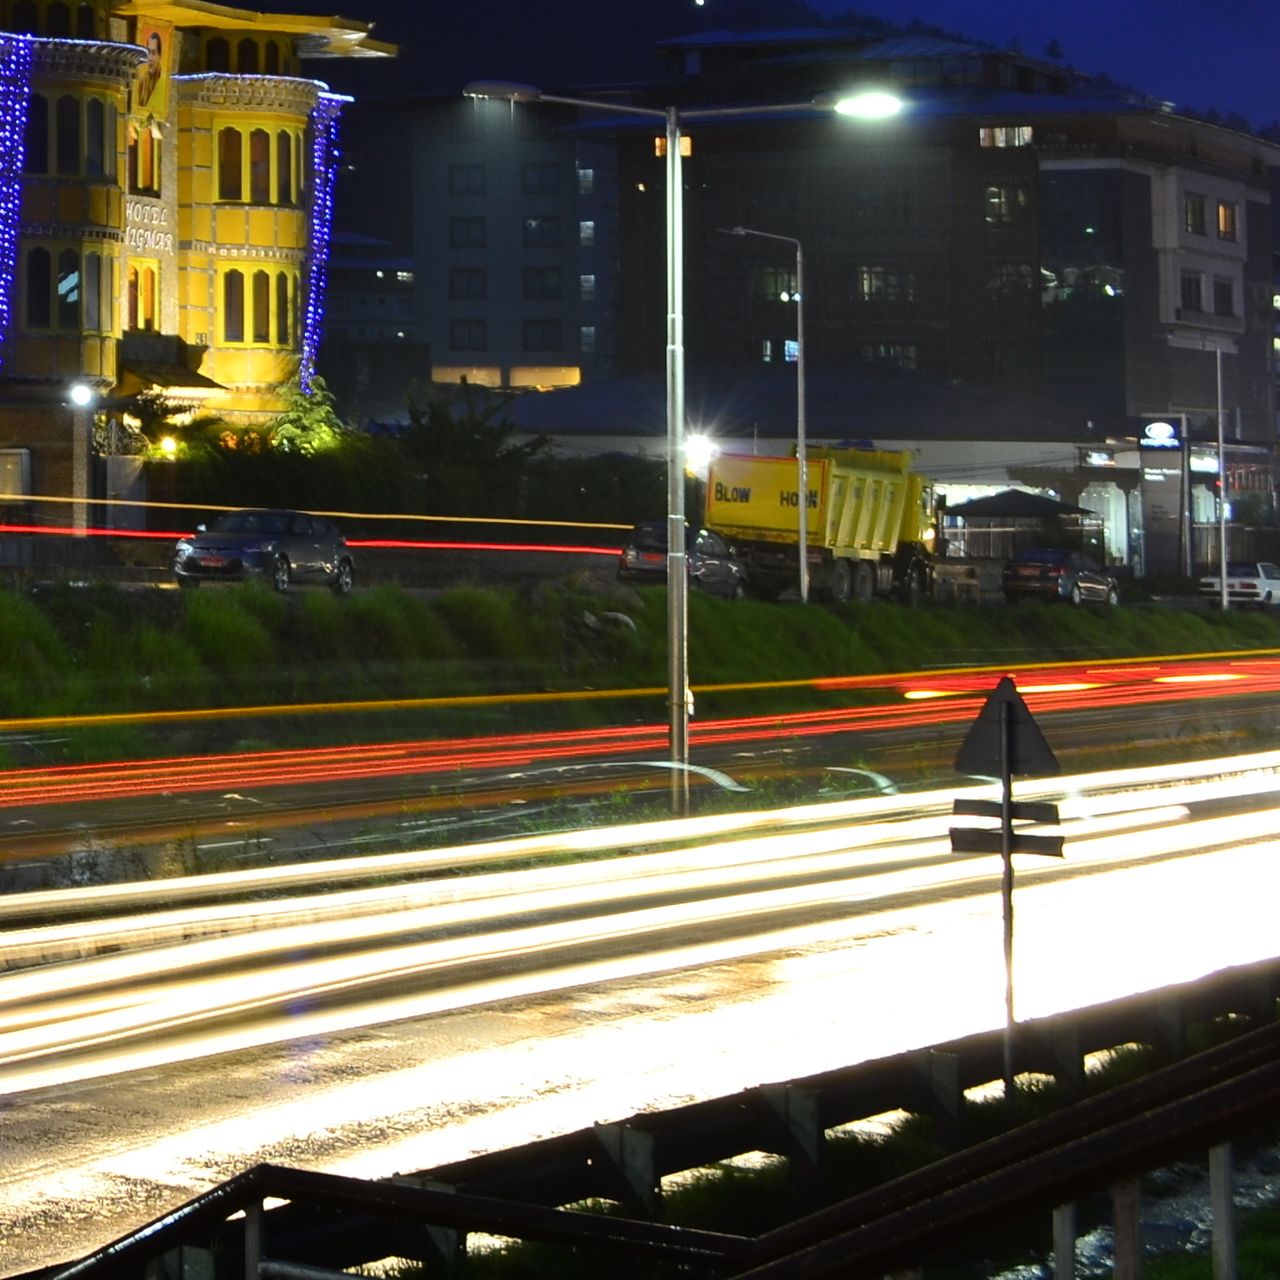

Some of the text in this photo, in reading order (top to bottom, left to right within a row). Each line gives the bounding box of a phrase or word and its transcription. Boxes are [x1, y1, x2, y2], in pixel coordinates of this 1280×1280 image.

[126, 201, 168, 225] HOTEL
[715, 483, 751, 503] BLOW
[780, 490, 818, 508] HON
